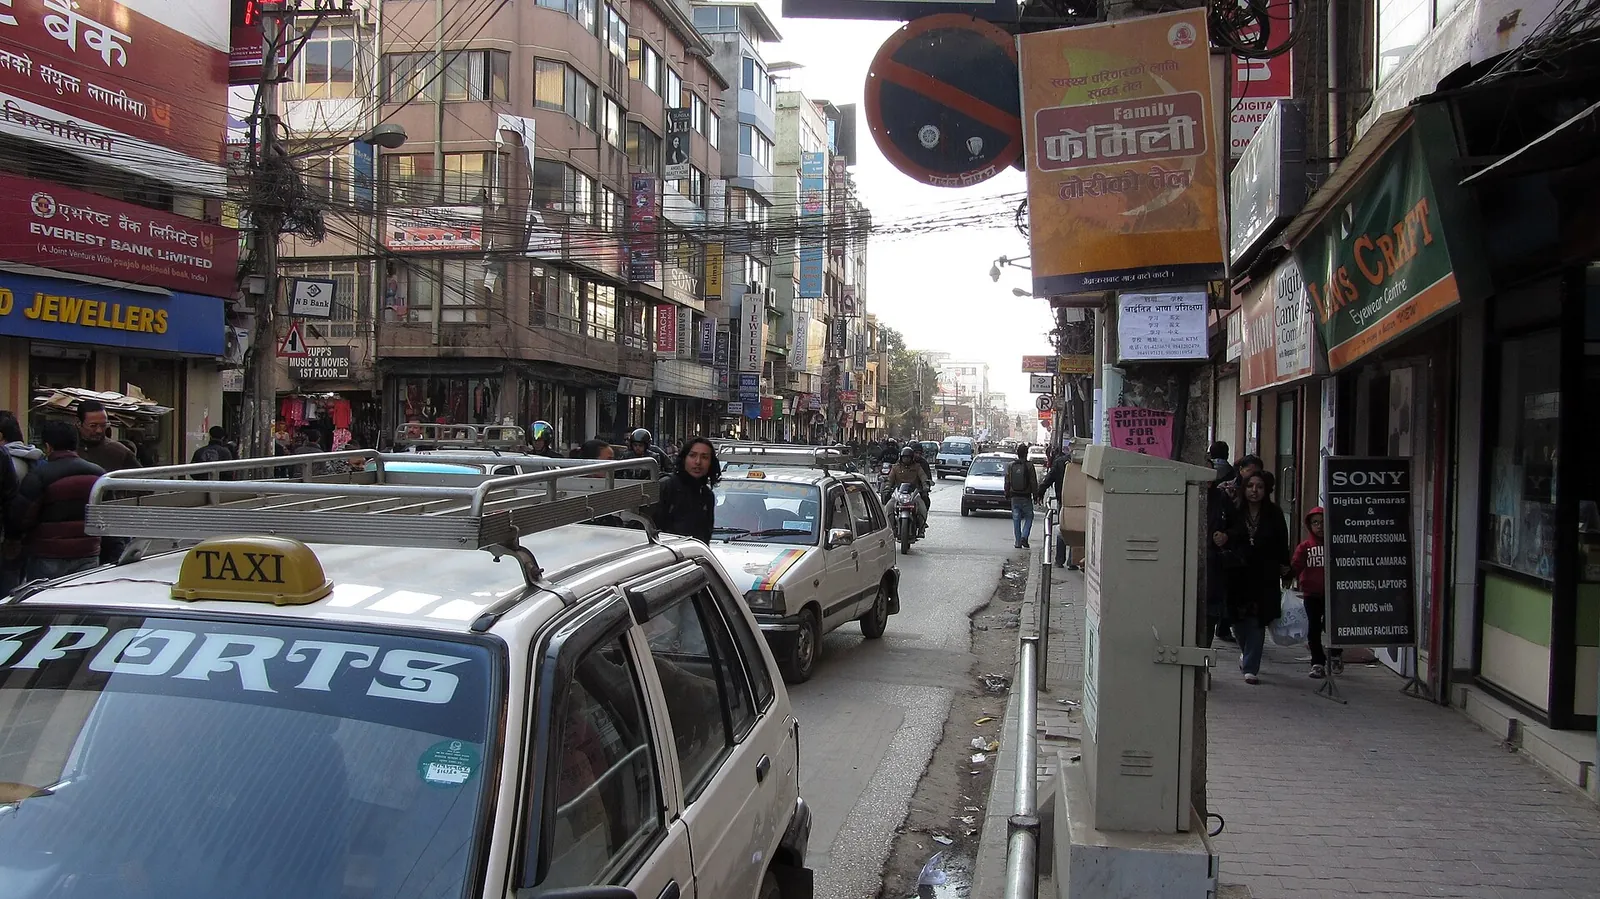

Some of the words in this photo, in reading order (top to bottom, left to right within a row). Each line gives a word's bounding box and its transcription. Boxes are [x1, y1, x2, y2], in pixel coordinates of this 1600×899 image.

[40, 63, 82, 95] संयुक्त
[1113, 102, 1175, 121] Family
[1236, 101, 1272, 111] DIGITA
[1058, 169, 1145, 200] तोरीको
[1149, 164, 1193, 189] तेल
[58, 202, 112, 227] एभरेष्ट
[118, 212, 142, 234] बैंक
[148, 220, 199, 248] लिमिटेड
[30, 222, 106, 247] EVEREST
[111, 239, 154, 258] BANK
[157, 249, 213, 269] LIMITED
[1353, 197, 1433, 286] CRAFT
[48, 245, 68, 257] Joint
[69, 249, 96, 262] Venture
[96, 254, 112, 264] With
[672, 268, 698, 295] SONY
[1278, 268, 1302, 302] Digit
[303, 298, 308, 306] B
[310, 297, 329, 308] Bank
[1155, 304, 1172, 312] भाषा
[1174, 302, 1203, 312] प्रशिक्षण
[1349, 295, 1383, 326] Eyewear
[1383, 278, 1408, 304] Centre
[24, 291, 169, 334] JEWELLERS
[1274, 297, 1312, 328] Cames
[748, 304, 759, 370] JEWELERS
[289, 358, 312, 367] MUSIC
[313, 358, 319, 367] &
[321, 357, 349, 367] MOVIES
[300, 368, 312, 378] 1ST
[314, 368, 338, 378] FLOOR
[1114, 418, 1167, 428] TUITION
[1128, 427, 1154, 437] FOR
[1125, 436, 1159, 446] S.L.C.
[1332, 471, 1405, 486] SONY
[1332, 496, 1362, 507] Digital
[1365, 496, 1406, 505] Camaras
[1367, 507, 1375, 515] &
[1344, 518, 1395, 527] Computers
[1332, 534, 1358, 544] DIGITAL
[1358, 533, 1407, 543] PROFESSIONAL
[195, 550, 285, 584] TAXI
[1335, 556, 1374, 567] VIDEO/STILL
[1375, 556, 1407, 566] CAMARAS
[1336, 580, 1377, 591] RECORDERS,
[1377, 579, 1407, 589] LAPTOPS
[1351, 603, 1357, 613] &
[1358, 602, 1379, 613] IPODS
[1379, 602, 1394, 612] with
[1337, 626, 1373, 637] REPAIRING
[1373, 625, 1409, 635] FACILITIES
[0, 624, 472, 705] SPORTS
